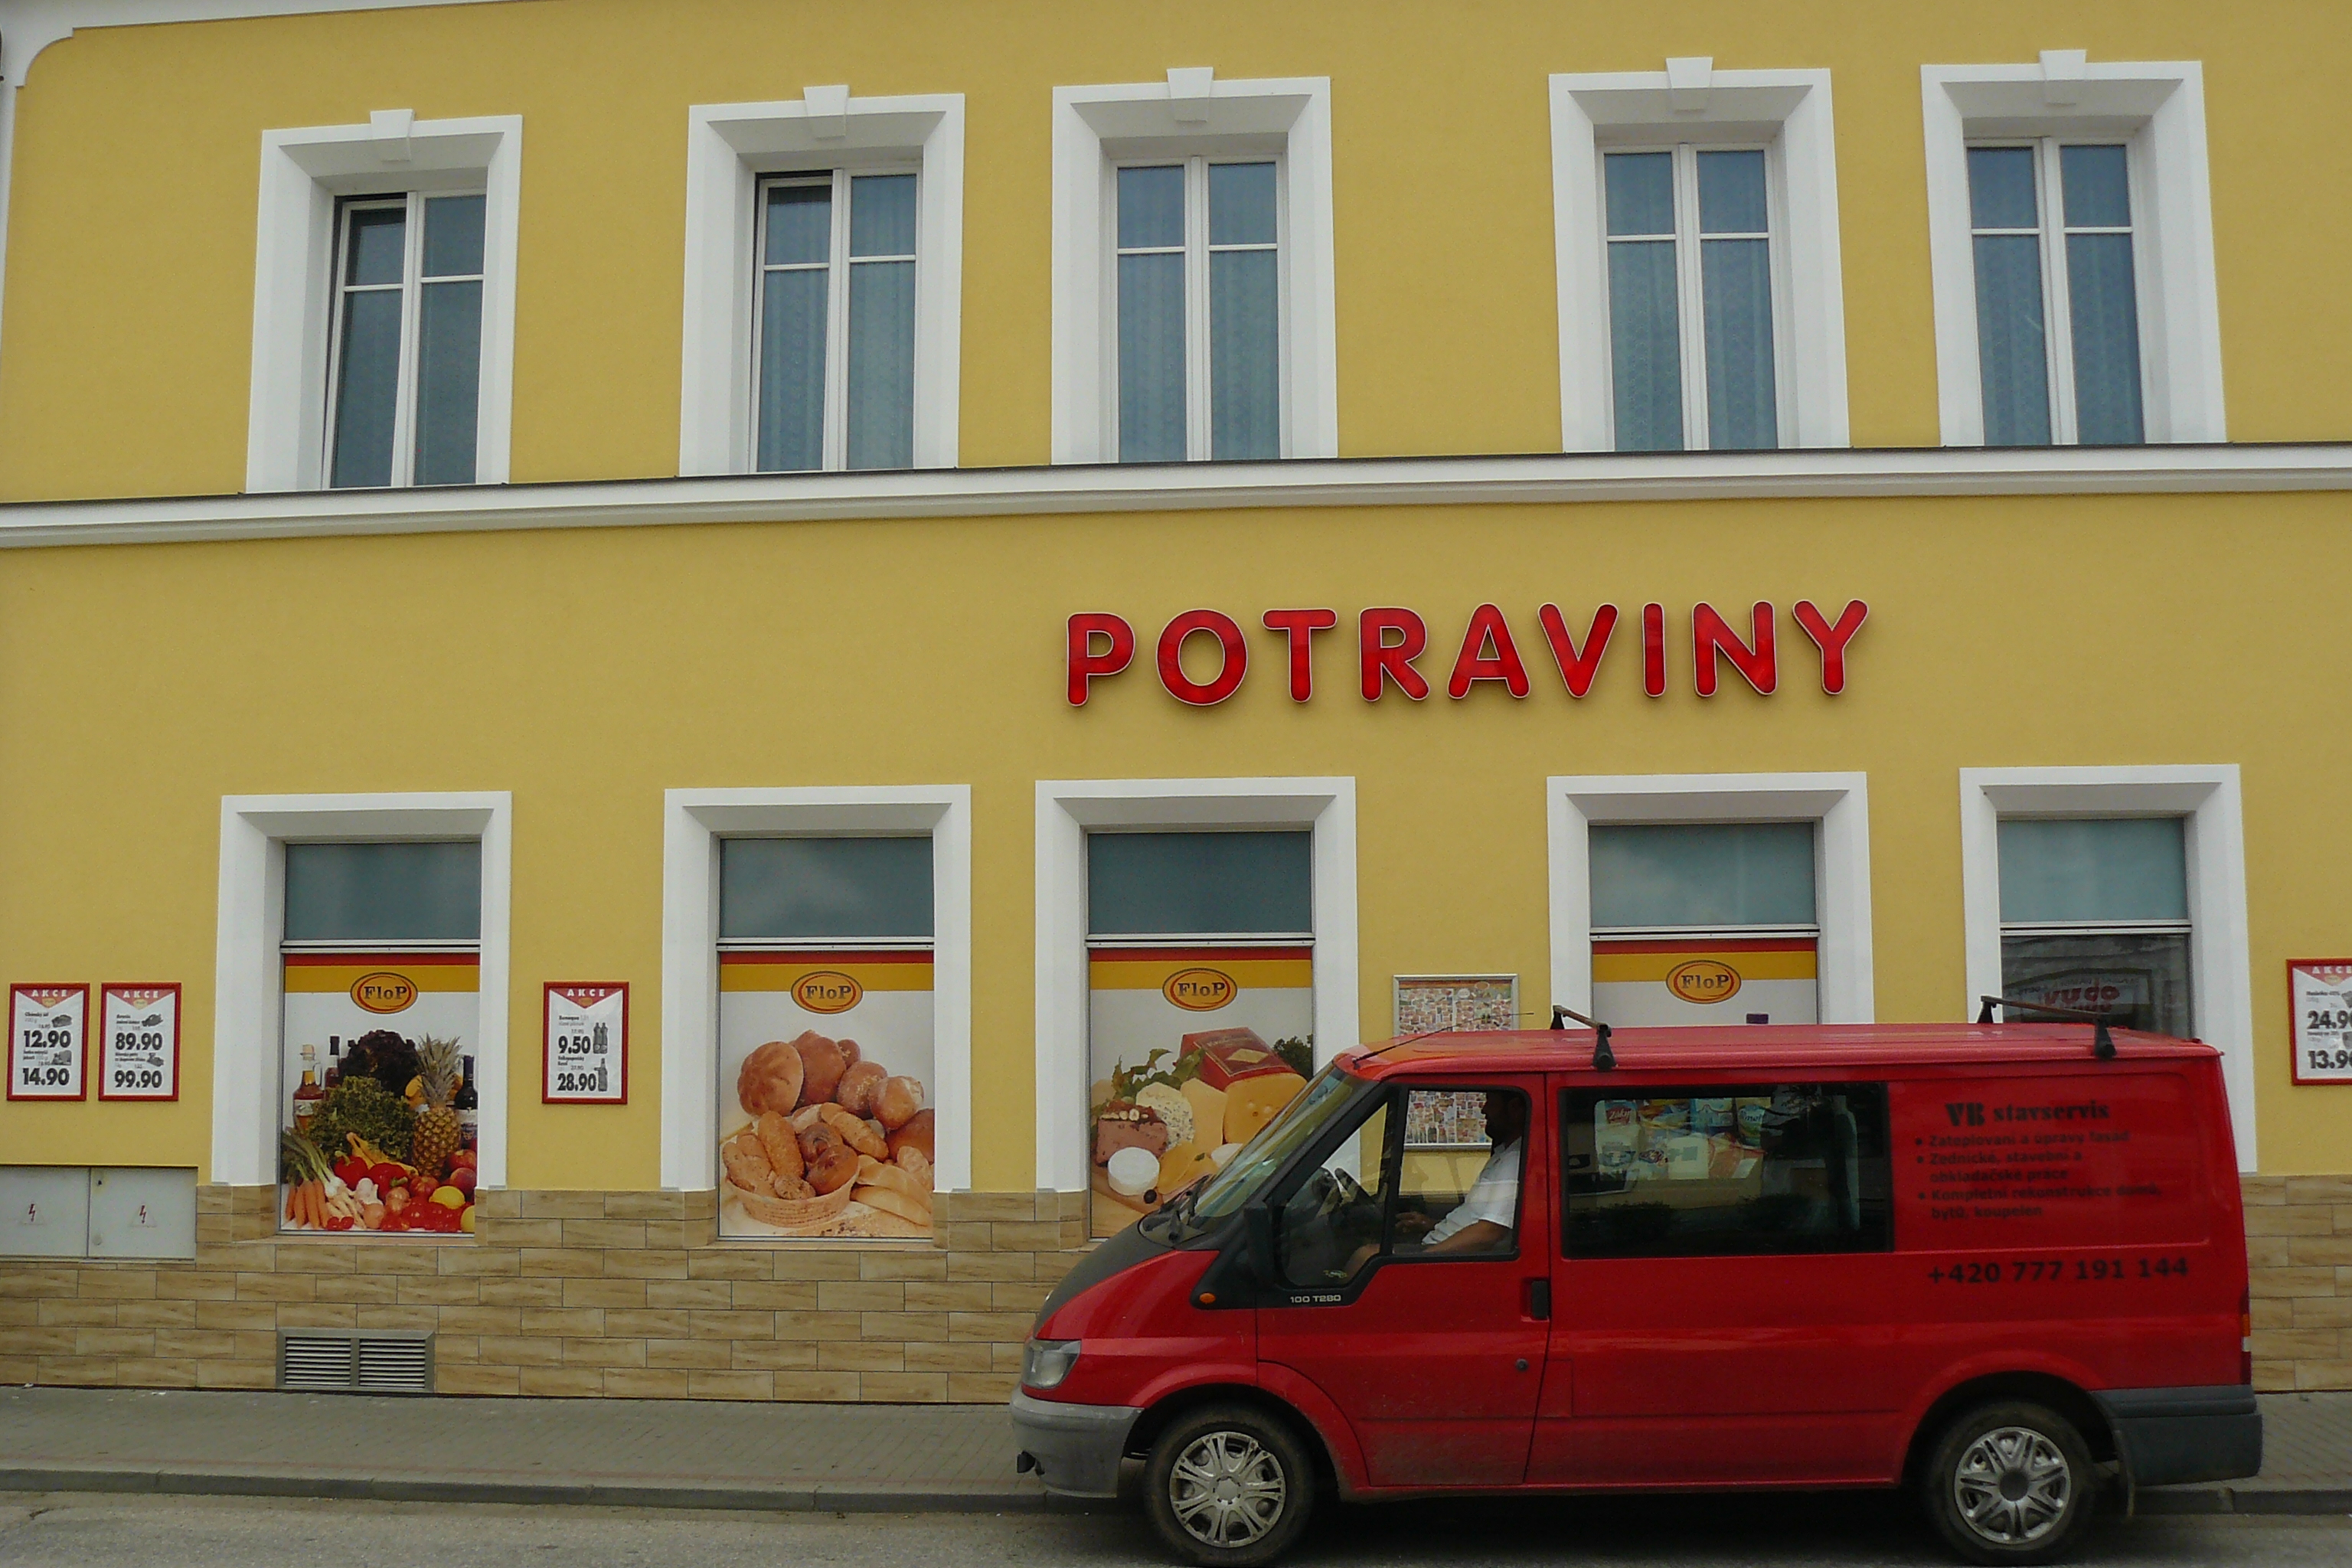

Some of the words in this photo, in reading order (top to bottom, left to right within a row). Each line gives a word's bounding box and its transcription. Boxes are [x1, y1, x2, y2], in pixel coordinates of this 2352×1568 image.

[1065, 599, 1869, 707] POTRAVINY
[2312, 966, 2352, 975] AKCE
[1178, 982, 1226, 997] FloP
[1681, 974, 1730, 989] FloP
[31, 989, 67, 998] AKCE
[122, 990, 159, 998] AKCE
[364, 985, 407, 1001] FloP
[567, 988, 606, 997] AKCE
[805, 985, 852, 1000] FloP
[2307, 1010, 2352, 1029] 24.9
[23, 1030, 71, 1048] 12.90
[116, 1032, 163, 1050] 89.90
[558, 1035, 592, 1054] 9.50
[2308, 1050, 2352, 1069] 13.9
[22, 1067, 70, 1086] 14.90
[115, 1070, 162, 1088] 99.90
[557, 1073, 597, 1092] 28.90
[1993, 1099, 2110, 1123] stavservis
[2020, 1135, 2030, 1145] a
[2073, 1151, 2082, 1161] a
[1927, 1262, 2001, 1285] +420
[2012, 1259, 2064, 1282] 777
[2076, 1259, 2125, 1280] 191
[2138, 1256, 2190, 1278] 144
[1312, 1294, 1341, 1302] T280
